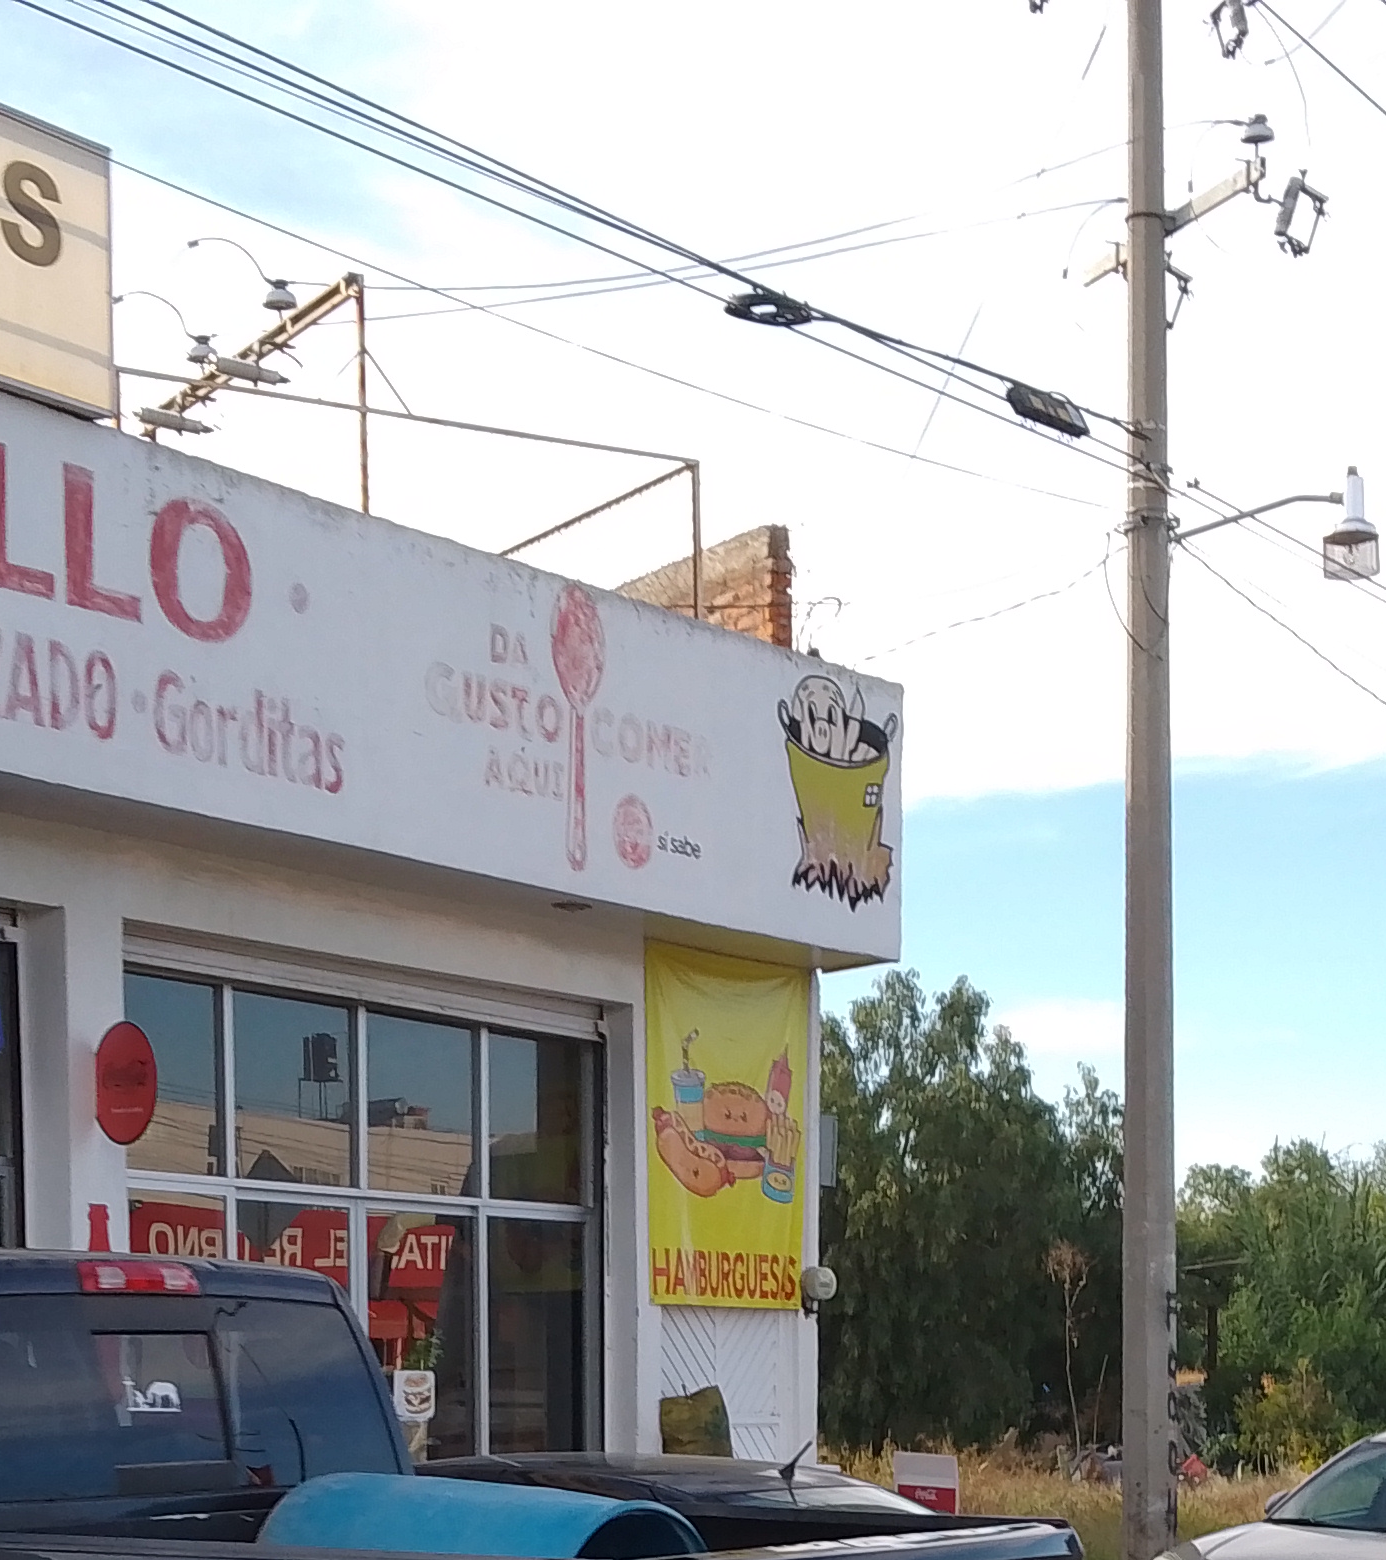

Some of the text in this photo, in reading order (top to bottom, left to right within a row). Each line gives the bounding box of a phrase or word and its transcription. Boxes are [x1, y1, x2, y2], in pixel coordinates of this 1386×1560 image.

[489, 622, 529, 664] DA
[153, 669, 346, 795] Gorditas
[424, 661, 563, 743] GUSTO
